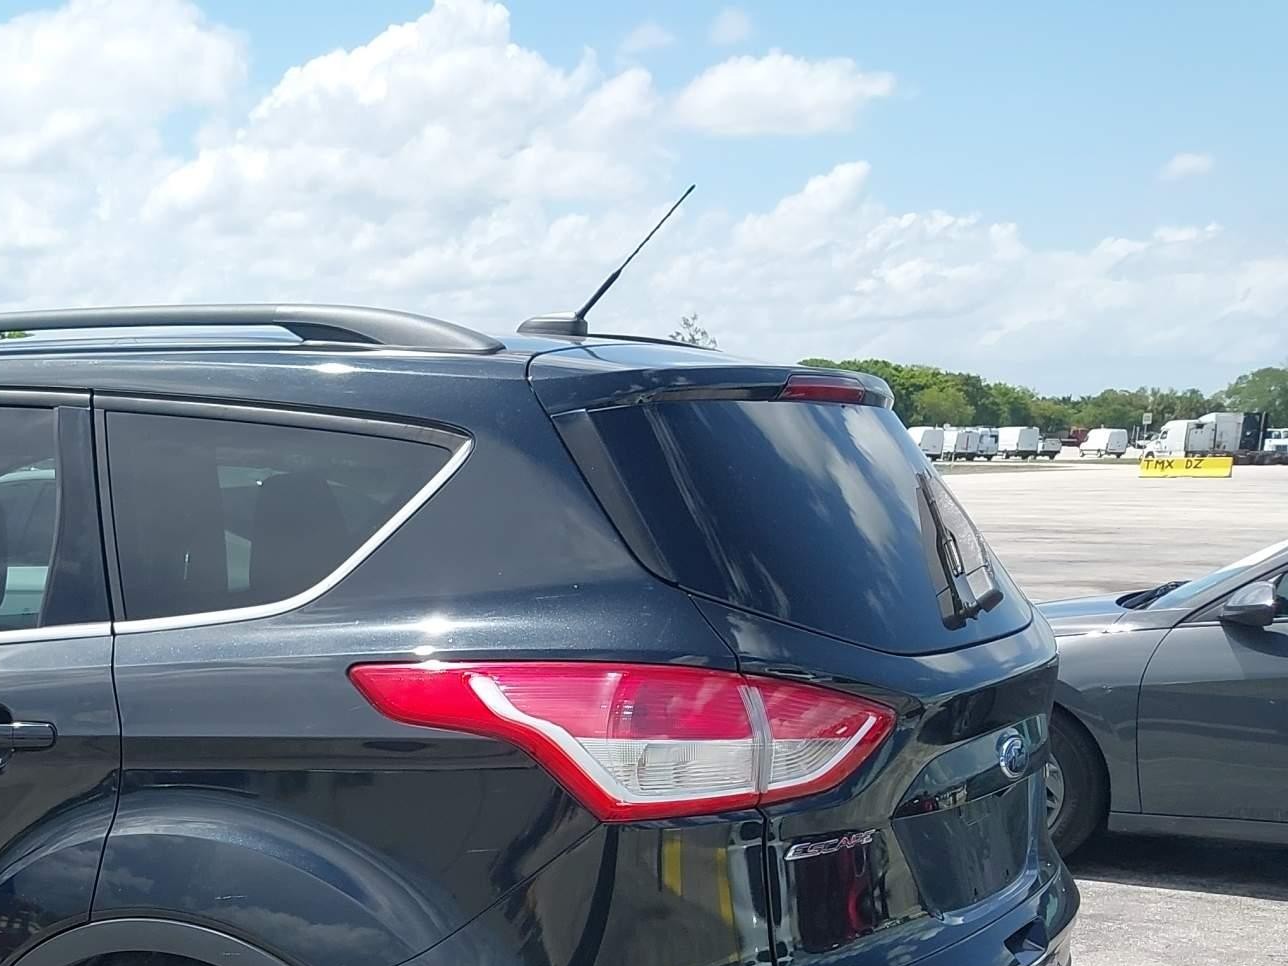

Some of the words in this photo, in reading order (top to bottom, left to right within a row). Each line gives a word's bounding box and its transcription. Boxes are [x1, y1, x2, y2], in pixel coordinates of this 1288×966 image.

[1143, 458, 1175, 471] TMX
[1185, 458, 1205, 470] DZ
[784, 829, 876, 861] ESCAPE
